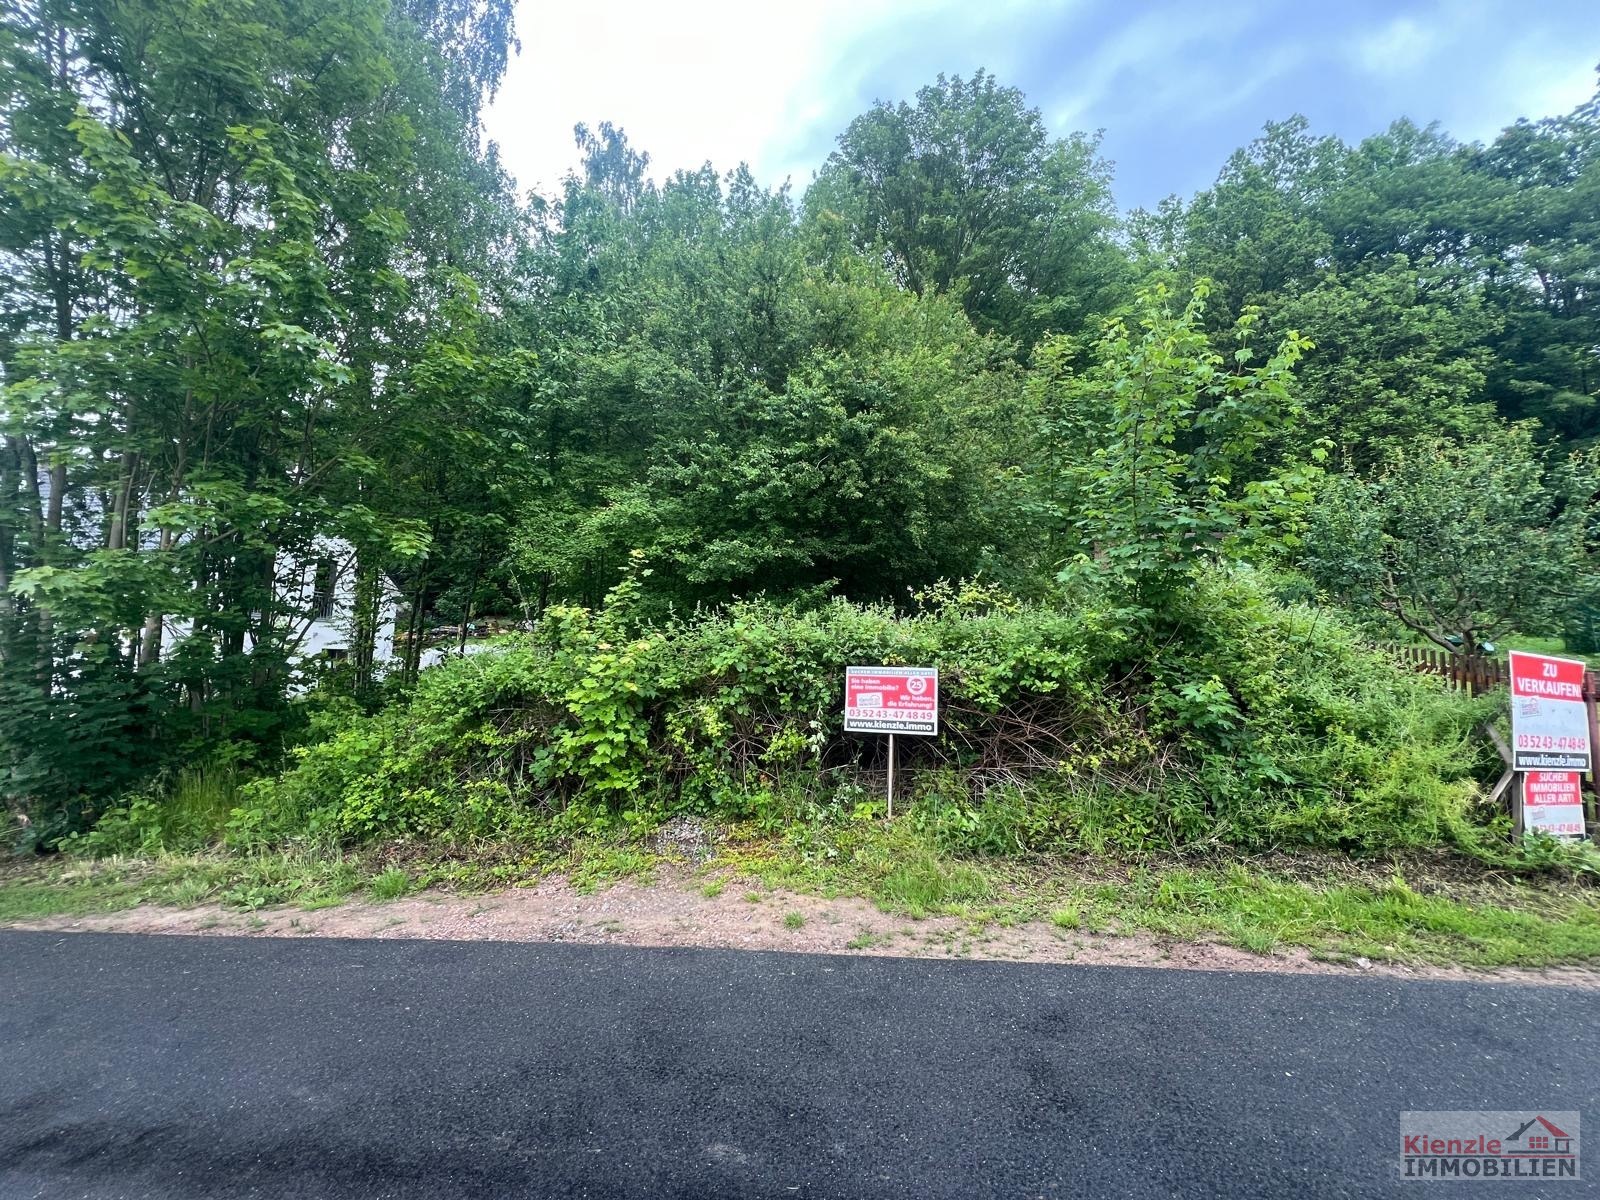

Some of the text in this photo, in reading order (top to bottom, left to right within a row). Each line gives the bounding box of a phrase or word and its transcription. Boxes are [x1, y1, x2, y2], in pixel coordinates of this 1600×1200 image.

[1542, 663, 1558, 678] ZU
[898, 701, 933, 709] Erfahrung!
[849, 721, 932, 731] www.kienzle.immo
[1518, 754, 1587, 767] www.kienzle.immo
[1538, 772, 1569, 782] SUCHEN
[1530, 783, 1575, 792] IMMOBILIEN
[1534, 793, 1557, 803] ALLER
